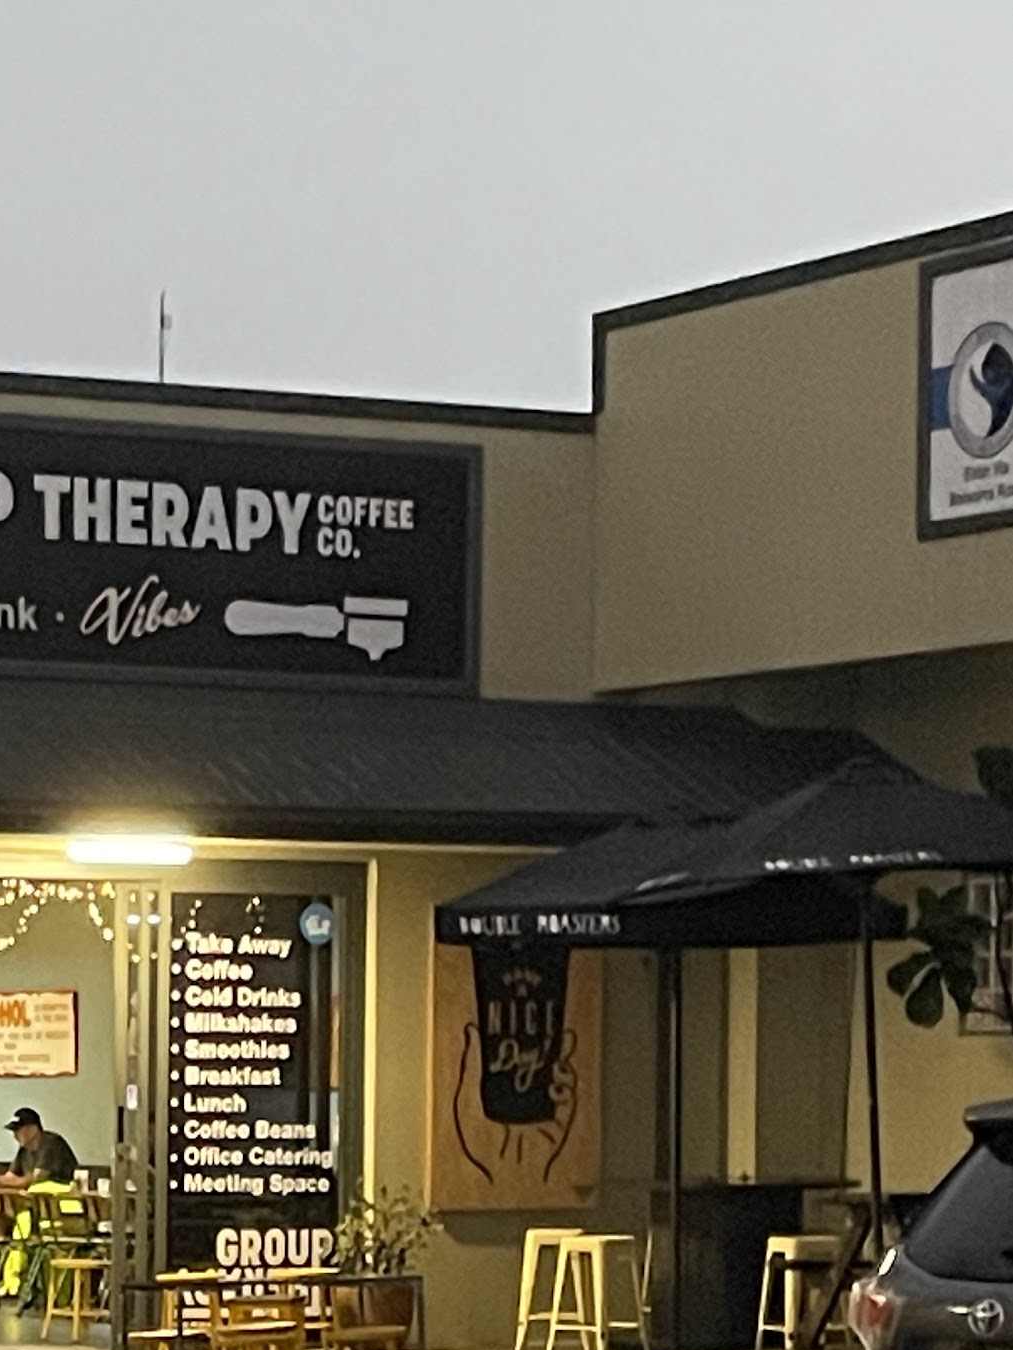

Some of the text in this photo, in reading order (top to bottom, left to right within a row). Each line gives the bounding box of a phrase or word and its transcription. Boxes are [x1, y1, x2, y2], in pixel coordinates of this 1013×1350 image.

[34, 474, 312, 555] THERAPY
[317, 495, 415, 530] COFFEE
[317, 526, 362, 559] CO.
[80, 574, 201, 645] Vibes
[185, 932, 292, 959] Take Away
[184, 958, 254, 981] Coffee
[184, 985, 302, 1008] Cold Drinks
[184, 1011, 298, 1033] Milkshakes
[184, 1038, 291, 1060] Smoothies
[184, 1065, 282, 1086] Breakfast
[183, 1092, 248, 1113] Lunch
[183, 1119, 317, 1139] Coffee Beans
[183, 1146, 334, 1169] Office Catering
[183, 1173, 331, 1196] Meeting Space
[216, 1228, 334, 1267] GROUP
